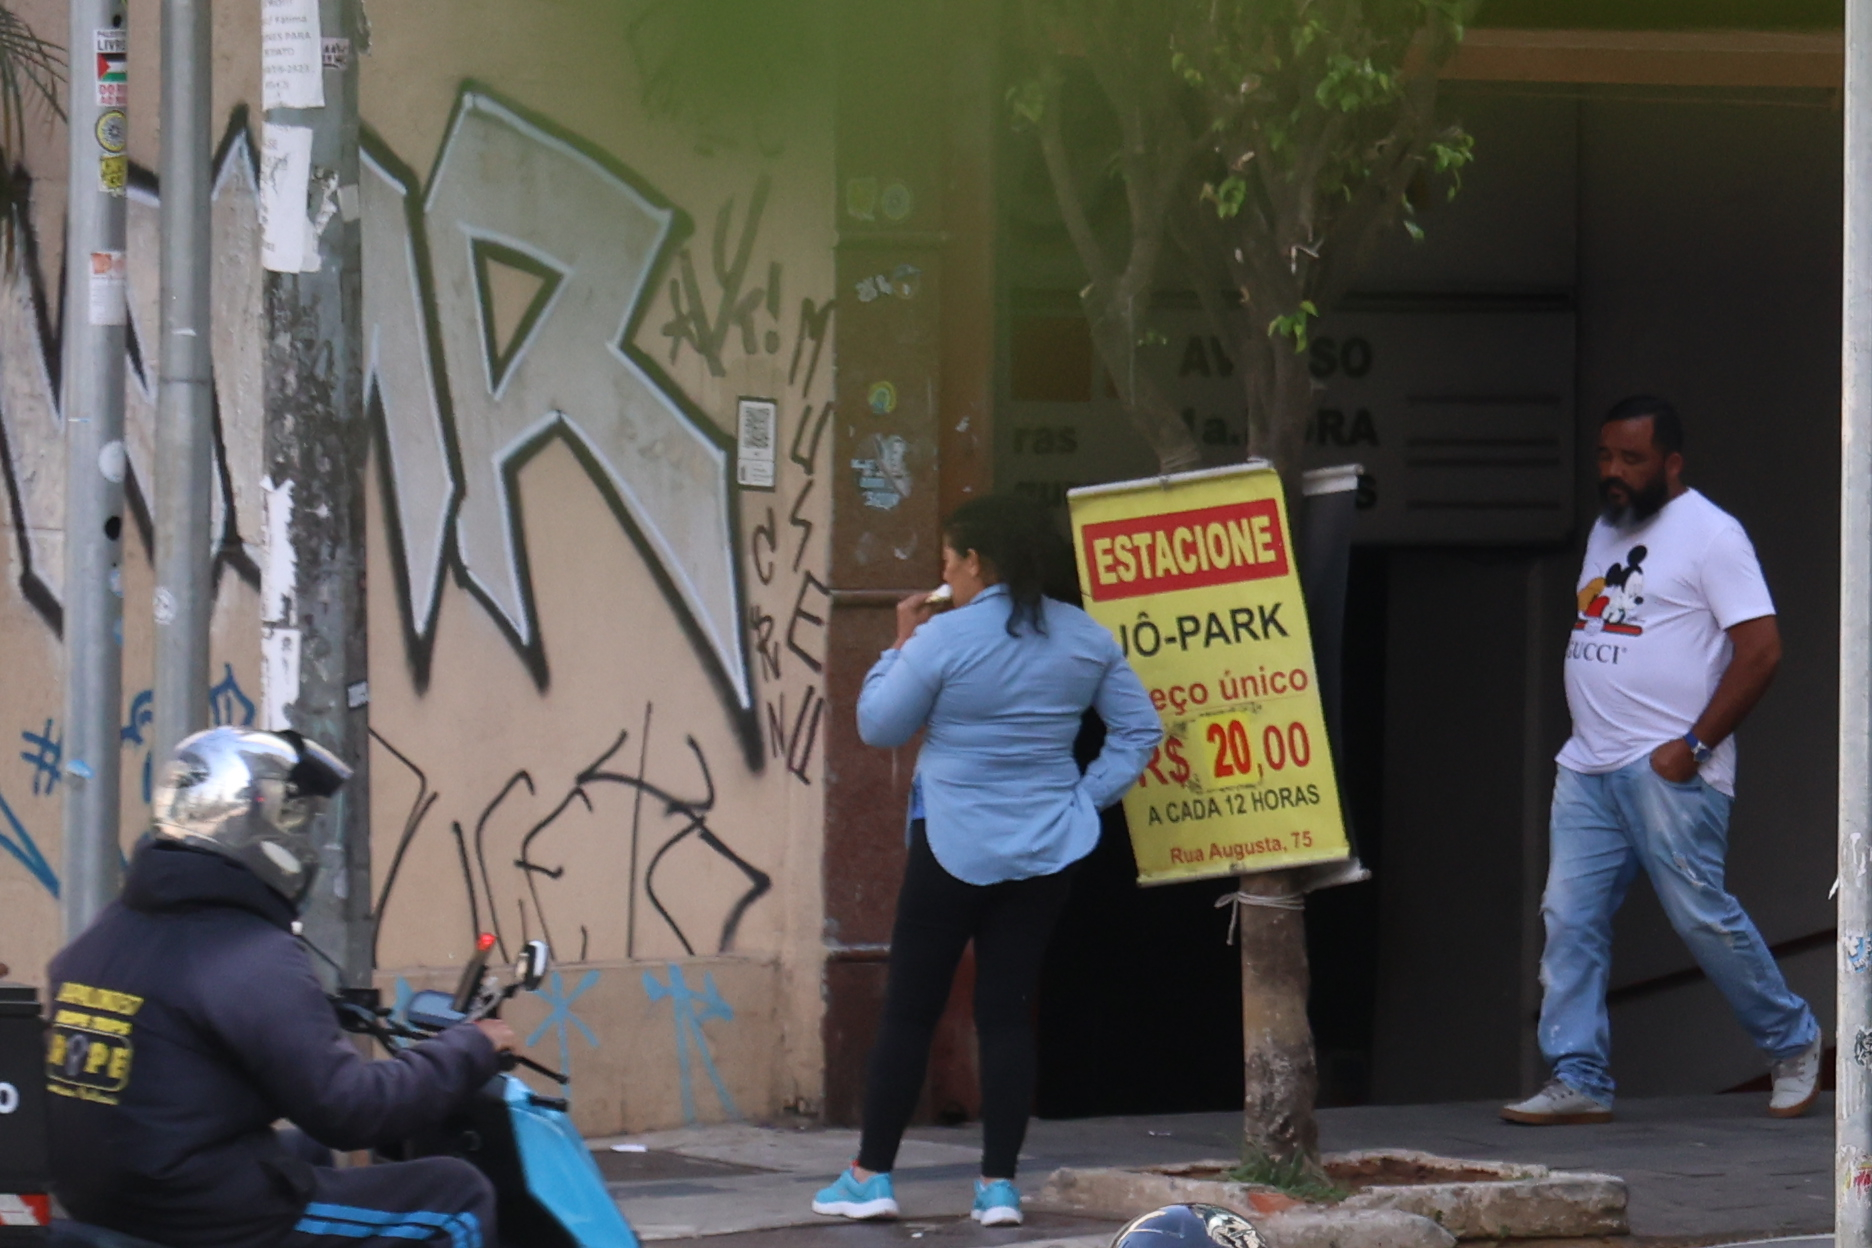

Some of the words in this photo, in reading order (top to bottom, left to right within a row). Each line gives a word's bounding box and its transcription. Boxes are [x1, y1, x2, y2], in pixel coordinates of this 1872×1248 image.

[1178, 335, 1372, 379] AVSO
[1092, 515, 1276, 586] ESTACIONE
[1150, 682, 1209, 716] eço
[1219, 665, 1308, 701] único
[1206, 719, 1311, 779] 20,00
[1148, 804, 1162, 826] A
[1165, 797, 1222, 824] CADA
[1226, 793, 1247, 817] 12
[1251, 784, 1320, 811] HORAS
[1170, 845, 1204, 865] Rua
[1208, 836, 1287, 861] Augusta,
[1290, 830, 1313, 849] 75
